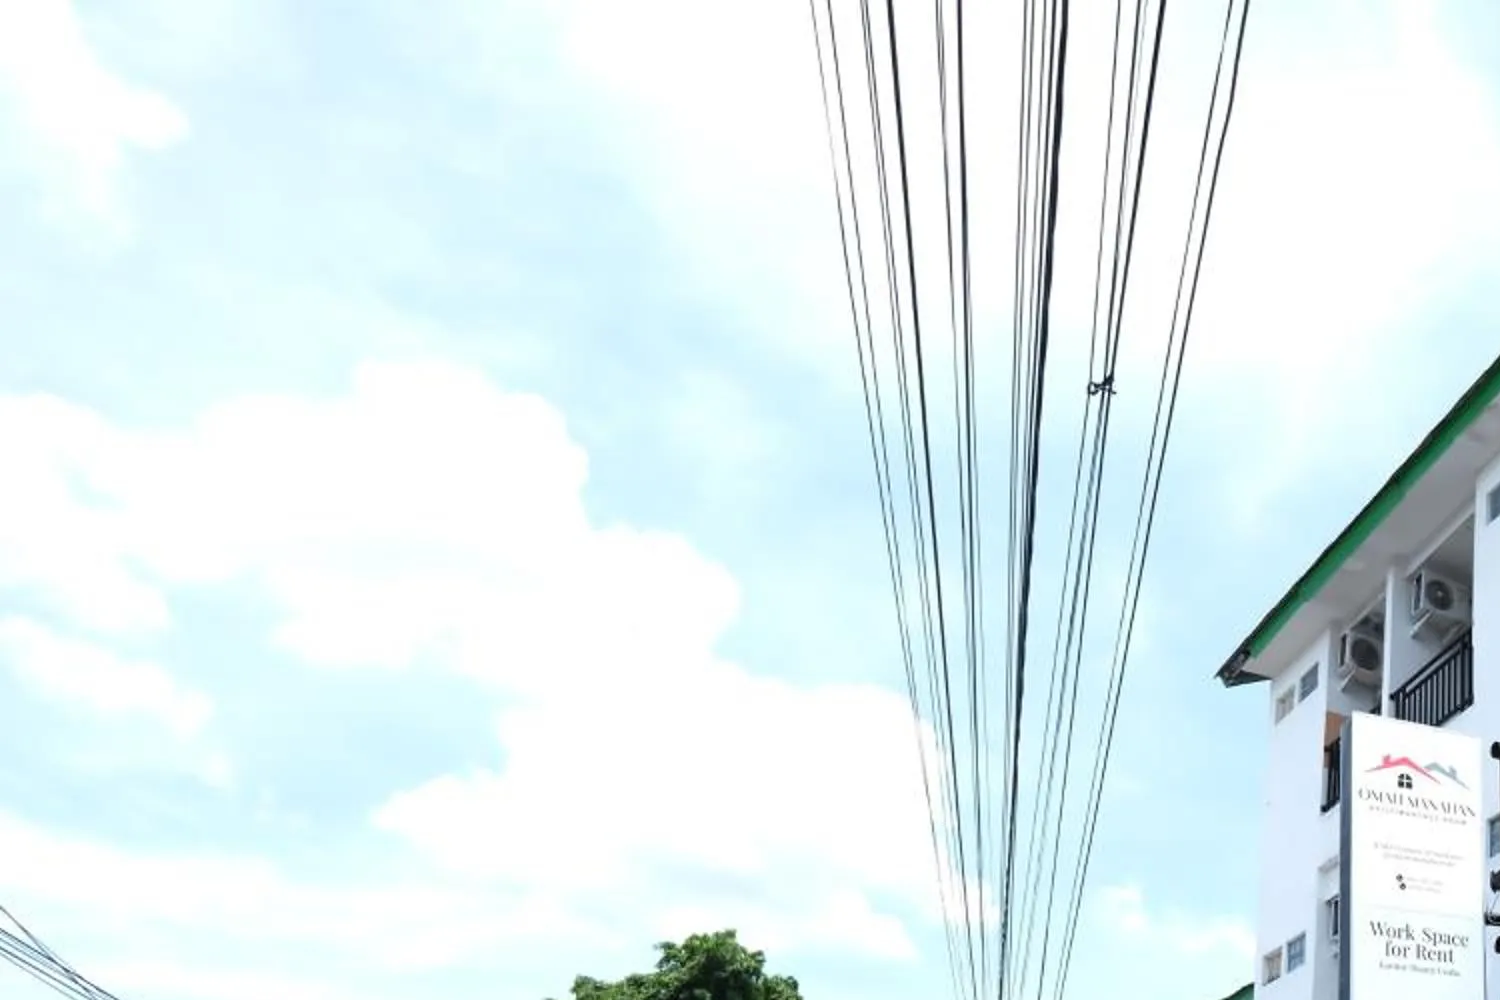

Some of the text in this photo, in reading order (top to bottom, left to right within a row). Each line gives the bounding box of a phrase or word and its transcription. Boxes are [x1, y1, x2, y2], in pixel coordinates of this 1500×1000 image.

[1369, 920, 1470, 948] Work Space
[1385, 940, 1455, 965] for Rent
